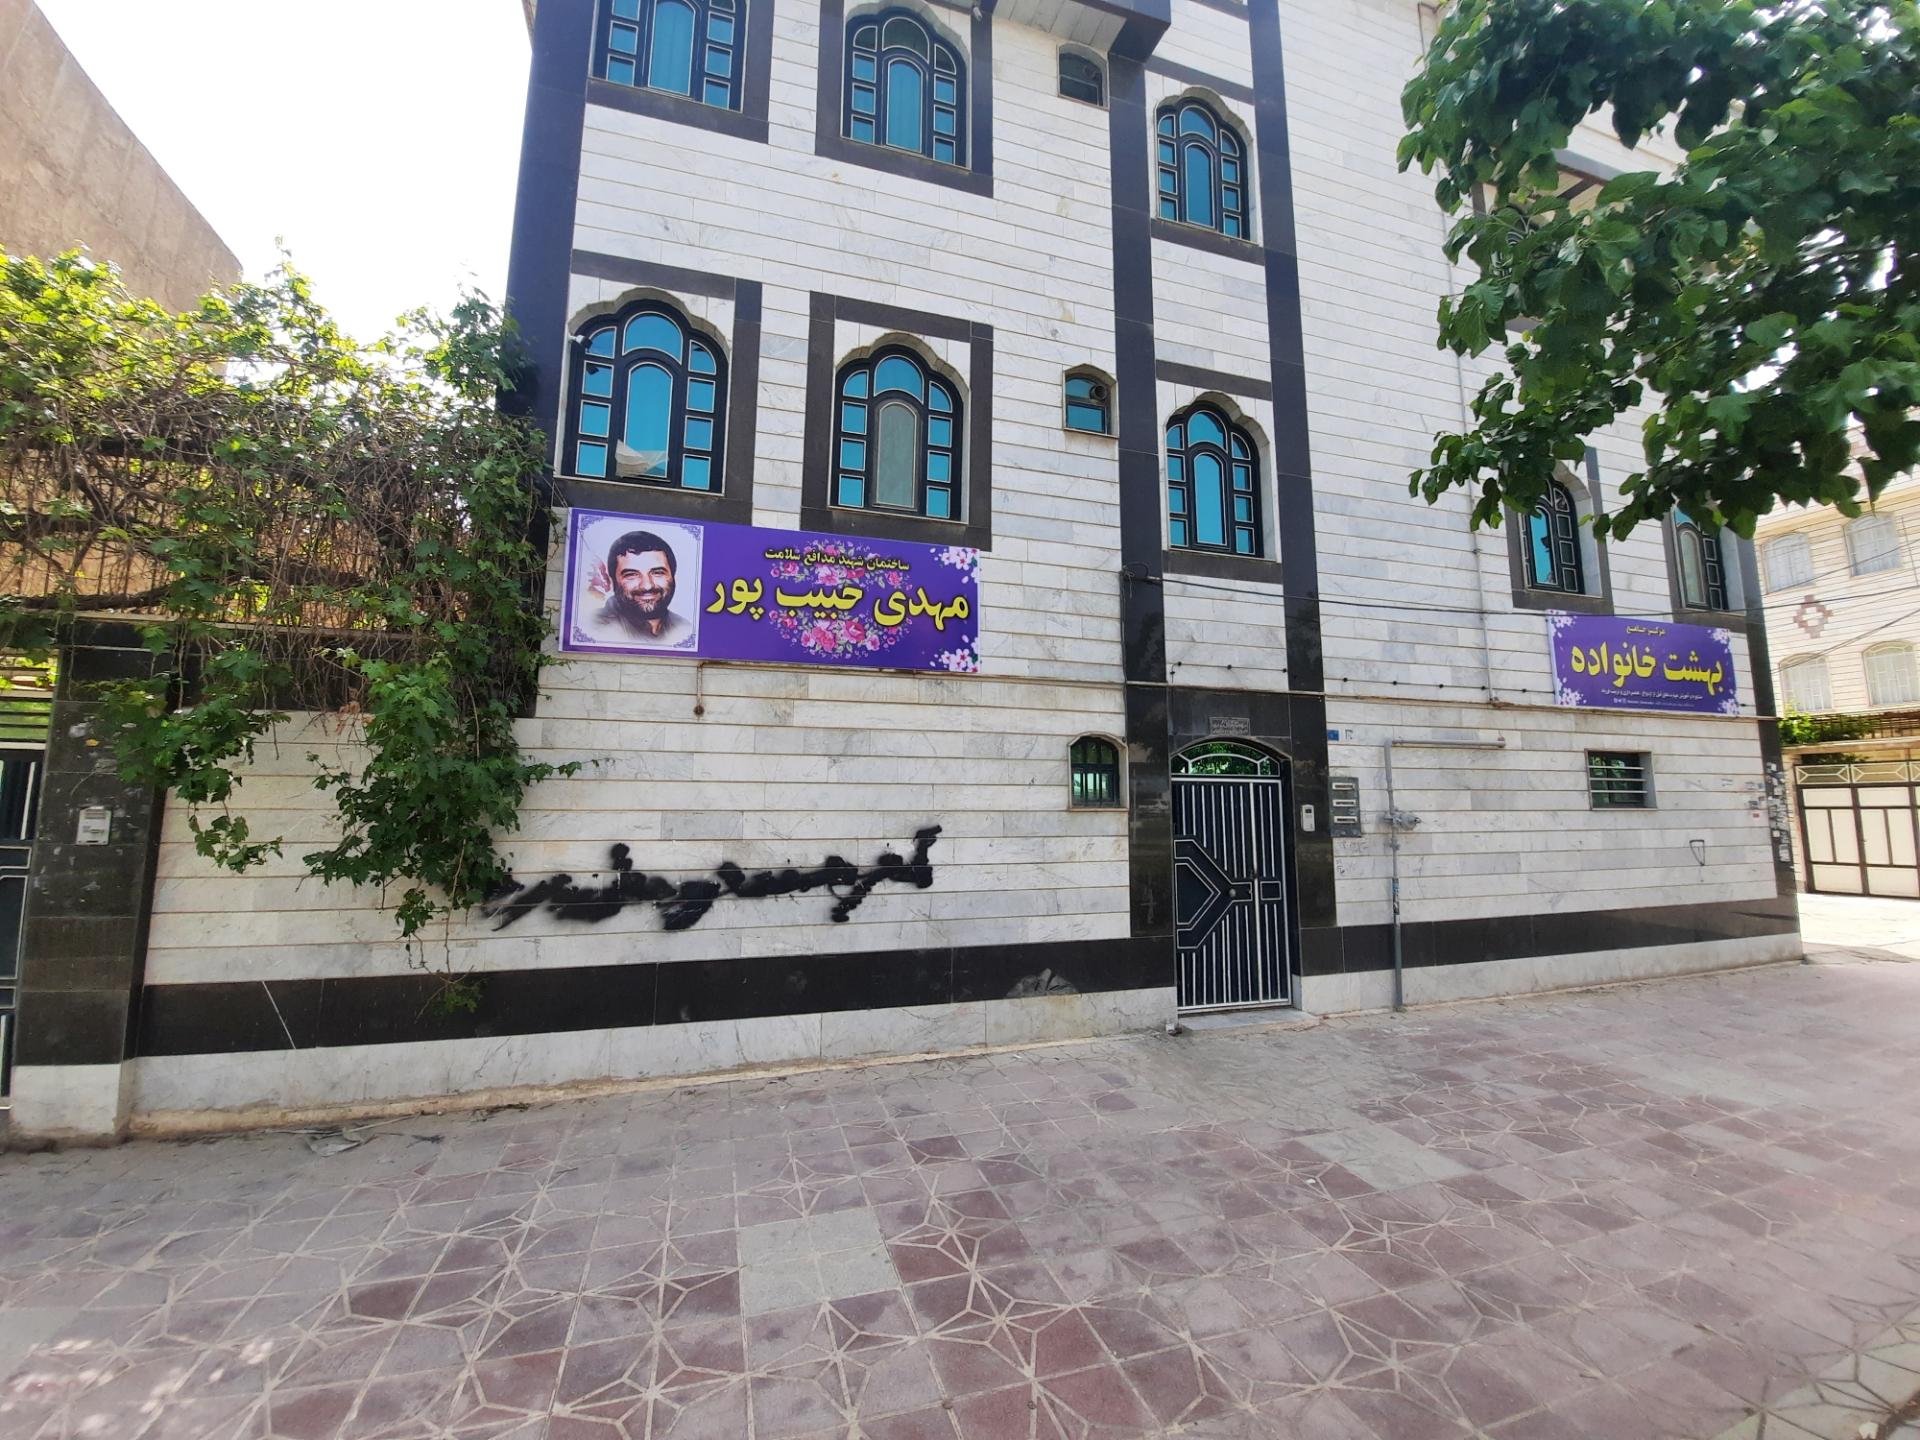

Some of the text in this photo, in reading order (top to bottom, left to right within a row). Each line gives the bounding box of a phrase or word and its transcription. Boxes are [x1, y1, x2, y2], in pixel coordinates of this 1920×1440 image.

[765, 548, 910, 571] ساختمان شهید مدافع سلامت
[706, 577, 969, 631] مهدی حبیب پور
[1571, 640, 1724, 696] بهشت خانواده
